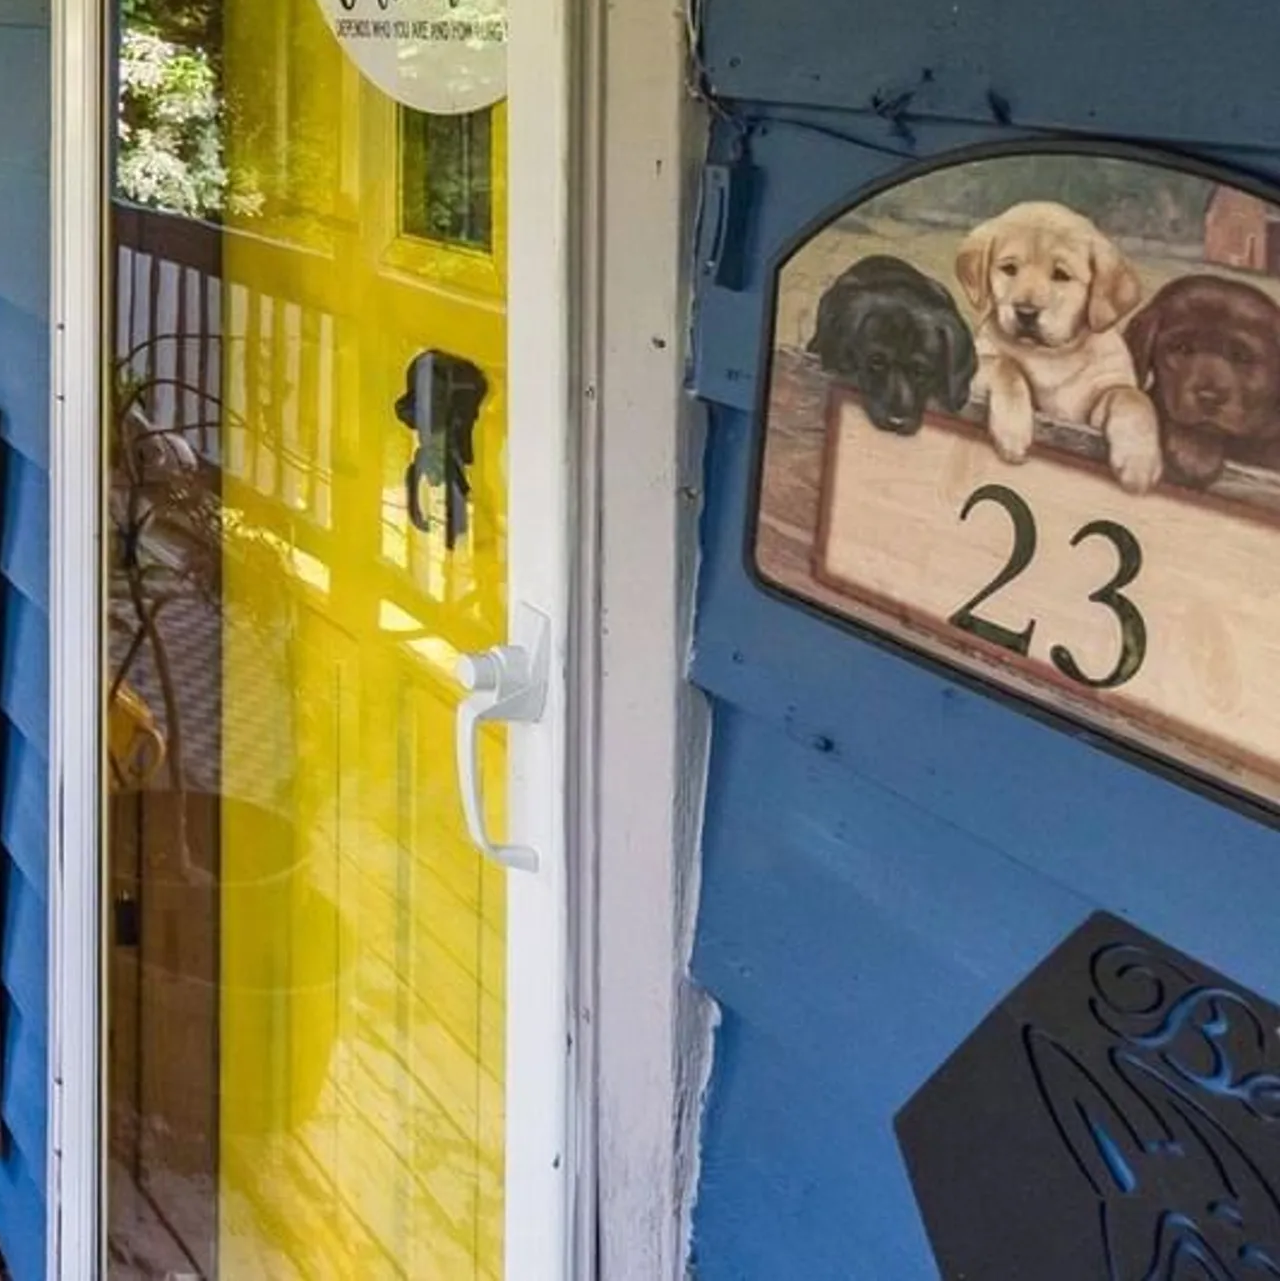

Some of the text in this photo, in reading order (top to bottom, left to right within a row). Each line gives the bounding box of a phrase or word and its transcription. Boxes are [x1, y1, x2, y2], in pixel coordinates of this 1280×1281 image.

[393, 21, 410, 39] YOU
[411, 21, 429, 39] ARE
[948, 482, 1147, 689] 23
